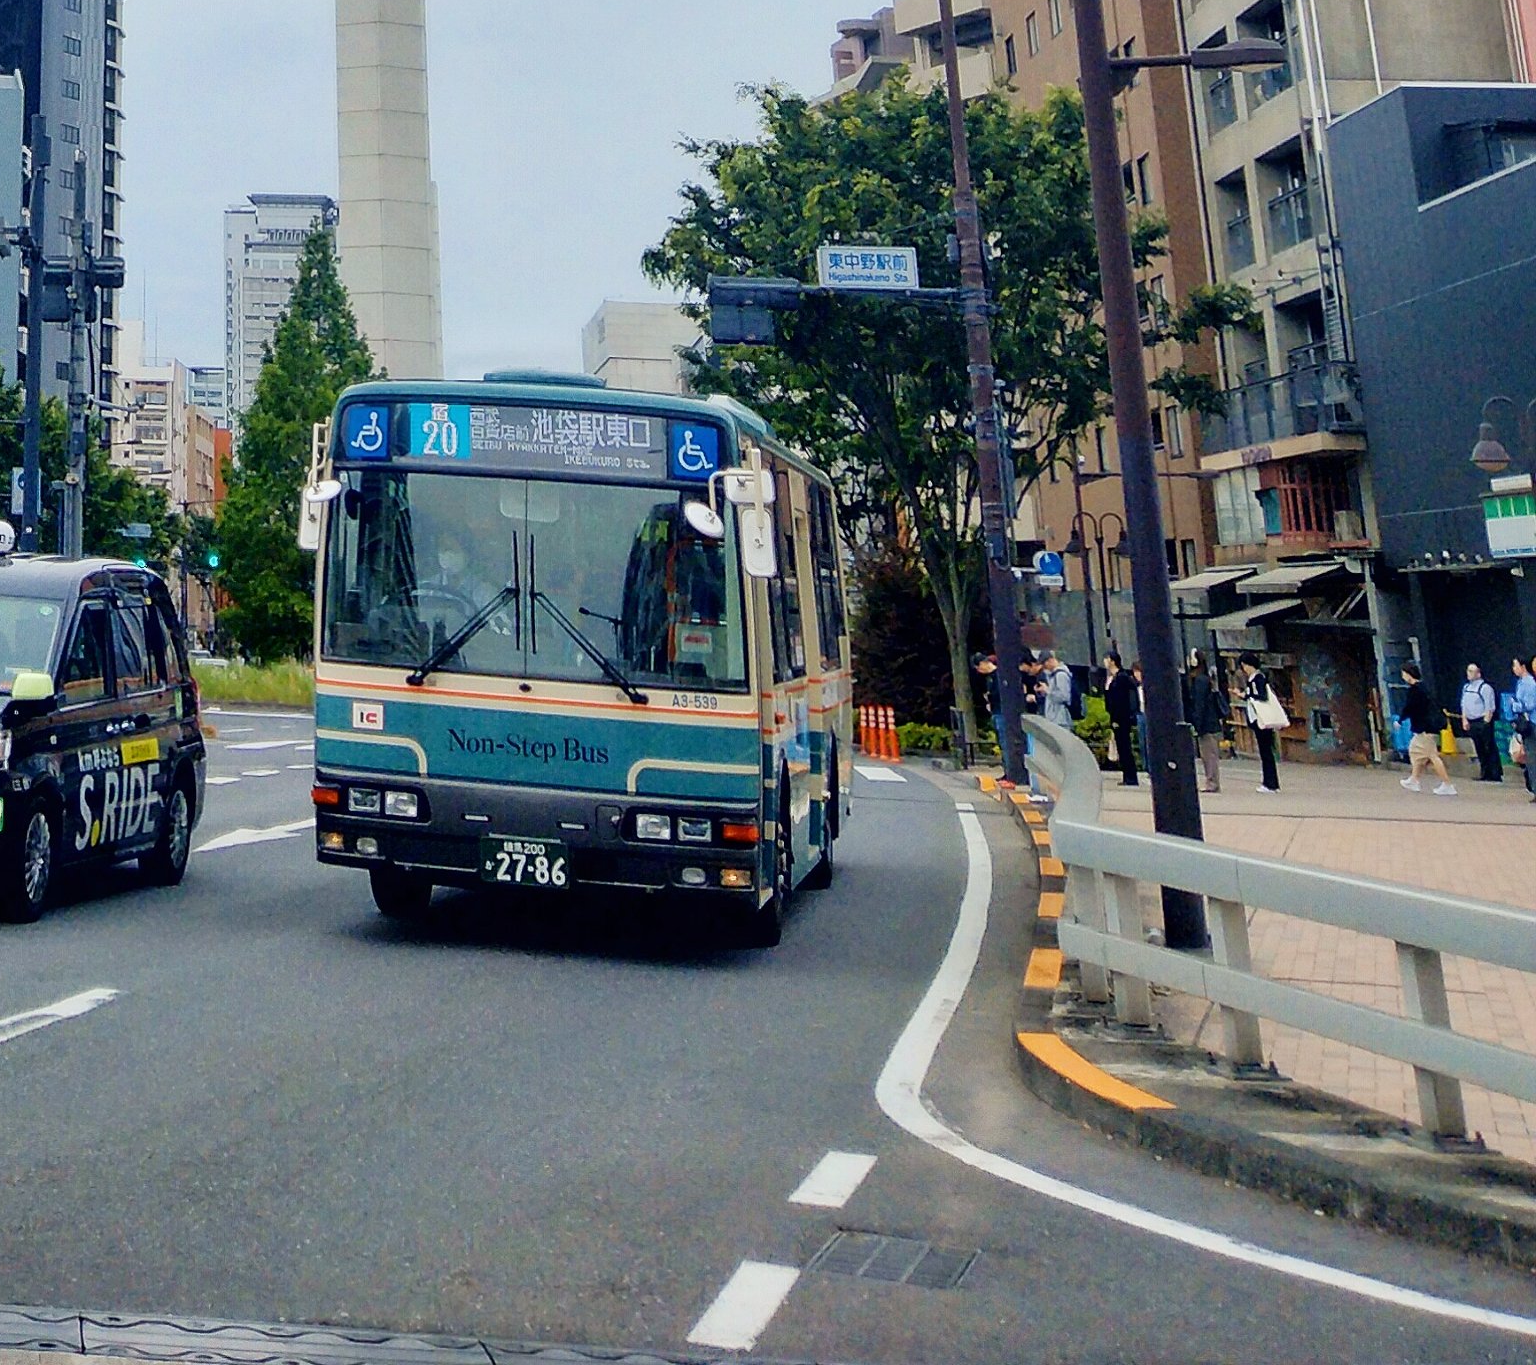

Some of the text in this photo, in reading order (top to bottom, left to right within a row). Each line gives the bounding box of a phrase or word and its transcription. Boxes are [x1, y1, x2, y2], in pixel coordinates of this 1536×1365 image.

[828, 252, 908, 272] 東中野駅前
[422, 420, 457, 456] 20
[530, 409, 651, 448] 池袋駅東口
[472, 439, 502, 450] SEIBU
[565, 455, 621, 467] IKEBUKURO
[672, 693, 718, 709] A3-539
[448, 728, 609, 764] Non-Step Bus
[75, 762, 160, 851] S.RIDE
